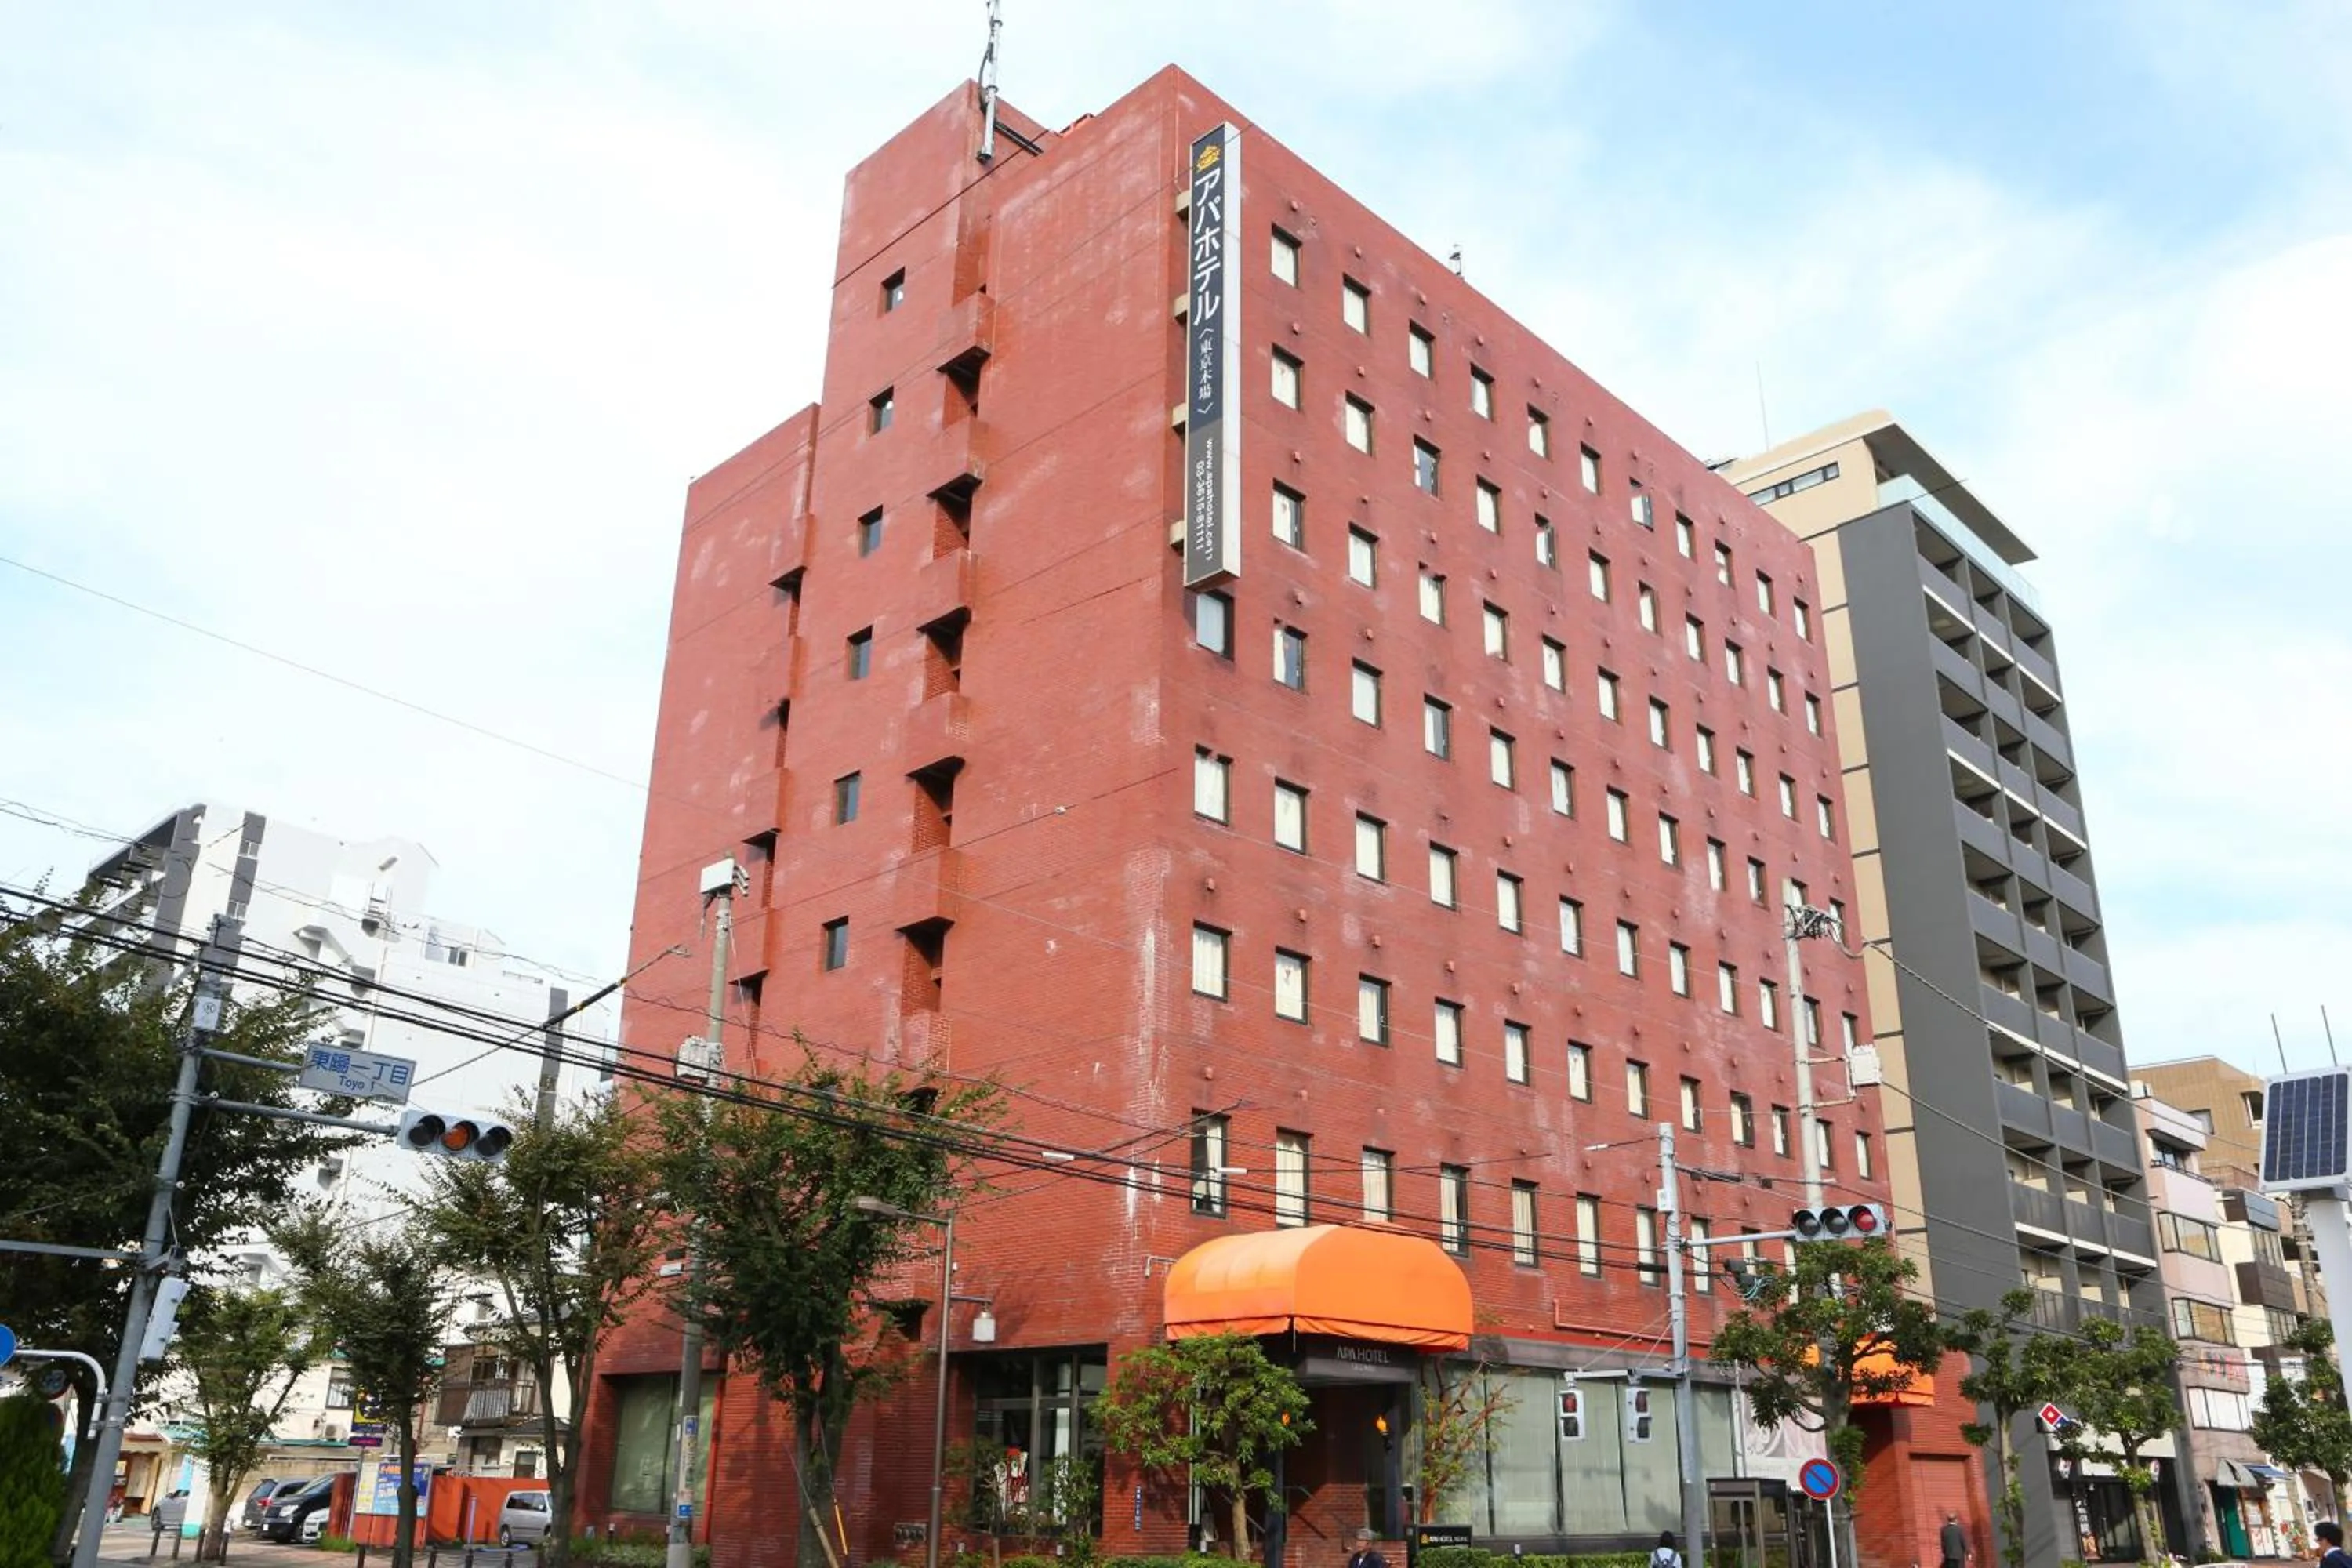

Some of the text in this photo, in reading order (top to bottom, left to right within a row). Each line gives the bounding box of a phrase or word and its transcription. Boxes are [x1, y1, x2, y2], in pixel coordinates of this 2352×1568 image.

[1193, 168, 1221, 326] アパホテル
[312, 1050, 409, 1086] 東陽一丁目
[339, 1075, 365, 1091] Toyo
[1357, 1348, 1391, 1364] HOTEL
